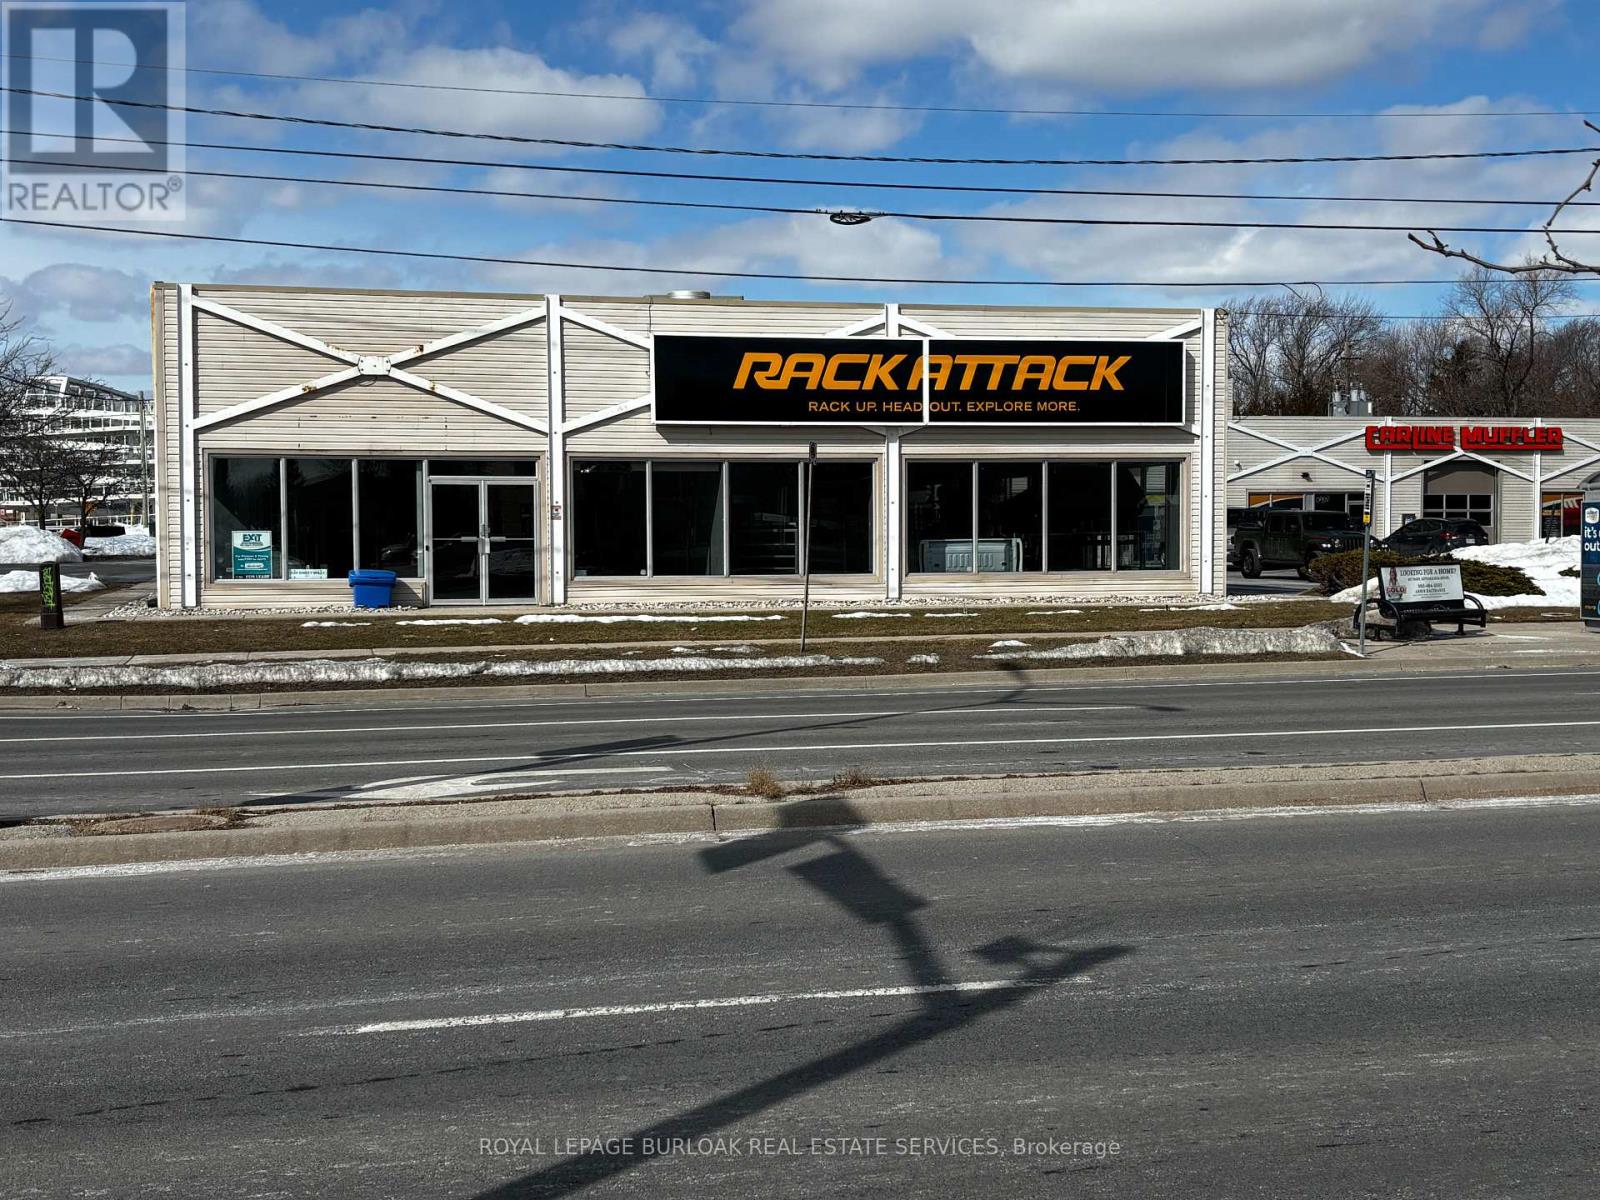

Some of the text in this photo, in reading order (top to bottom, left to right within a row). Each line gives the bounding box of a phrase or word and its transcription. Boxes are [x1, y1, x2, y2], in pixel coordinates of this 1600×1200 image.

[733, 352, 1132, 390] RACK ATTACK
[808, 401, 1080, 412] RACK UP. HEAD OUT. EXPLORE MORE.
[1365, 426, 1563, 450] CARLINE MUFFLER
[243, 534, 262, 542] EXIT
[1584, 526, 1597, 538] it's
